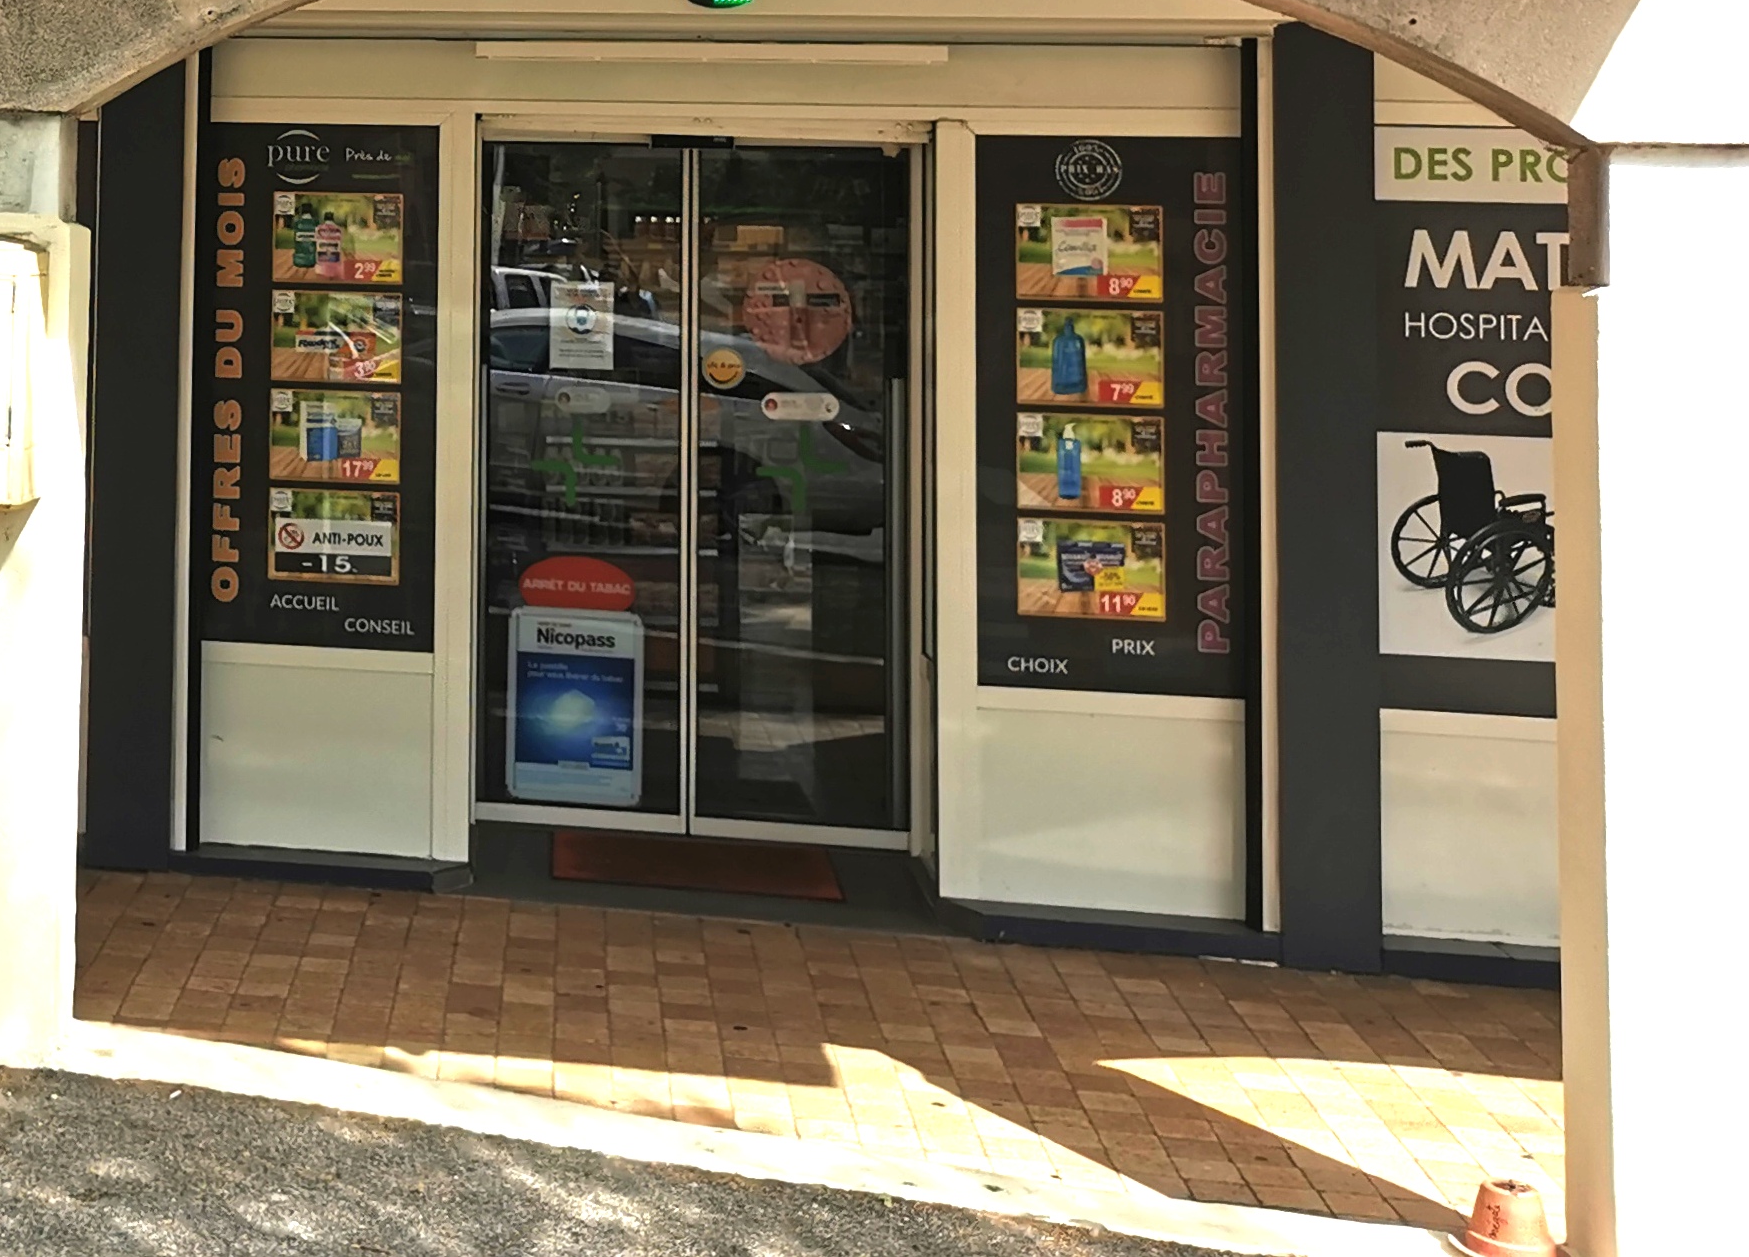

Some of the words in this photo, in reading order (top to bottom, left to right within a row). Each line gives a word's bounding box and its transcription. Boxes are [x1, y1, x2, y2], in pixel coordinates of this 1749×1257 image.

[267, 144, 331, 168] pure
[376, 149, 392, 162] de
[1393, 147, 1473, 182] DES
[216, 157, 246, 288] MOIS
[1404, 228, 1570, 291] MAT
[1404, 311, 1549, 342] HOSPITA
[215, 309, 243, 379] DU
[1446, 360, 1552, 417] CO
[1193, 171, 1231, 654] PARAPHARMACIE
[211, 399, 242, 603] OFFRES
[312, 532, 383, 547] ANTI-POUX
[567, 580, 587, 592] DU
[590, 582, 631, 595] TABAC
[270, 594, 340, 611] ACCUEIL
[344, 618, 415, 635] CONSEIL
[536, 627, 616, 650] Nicopass
[1112, 638, 1155, 656] PRIX
[1007, 656, 1069, 675] CHOIX
